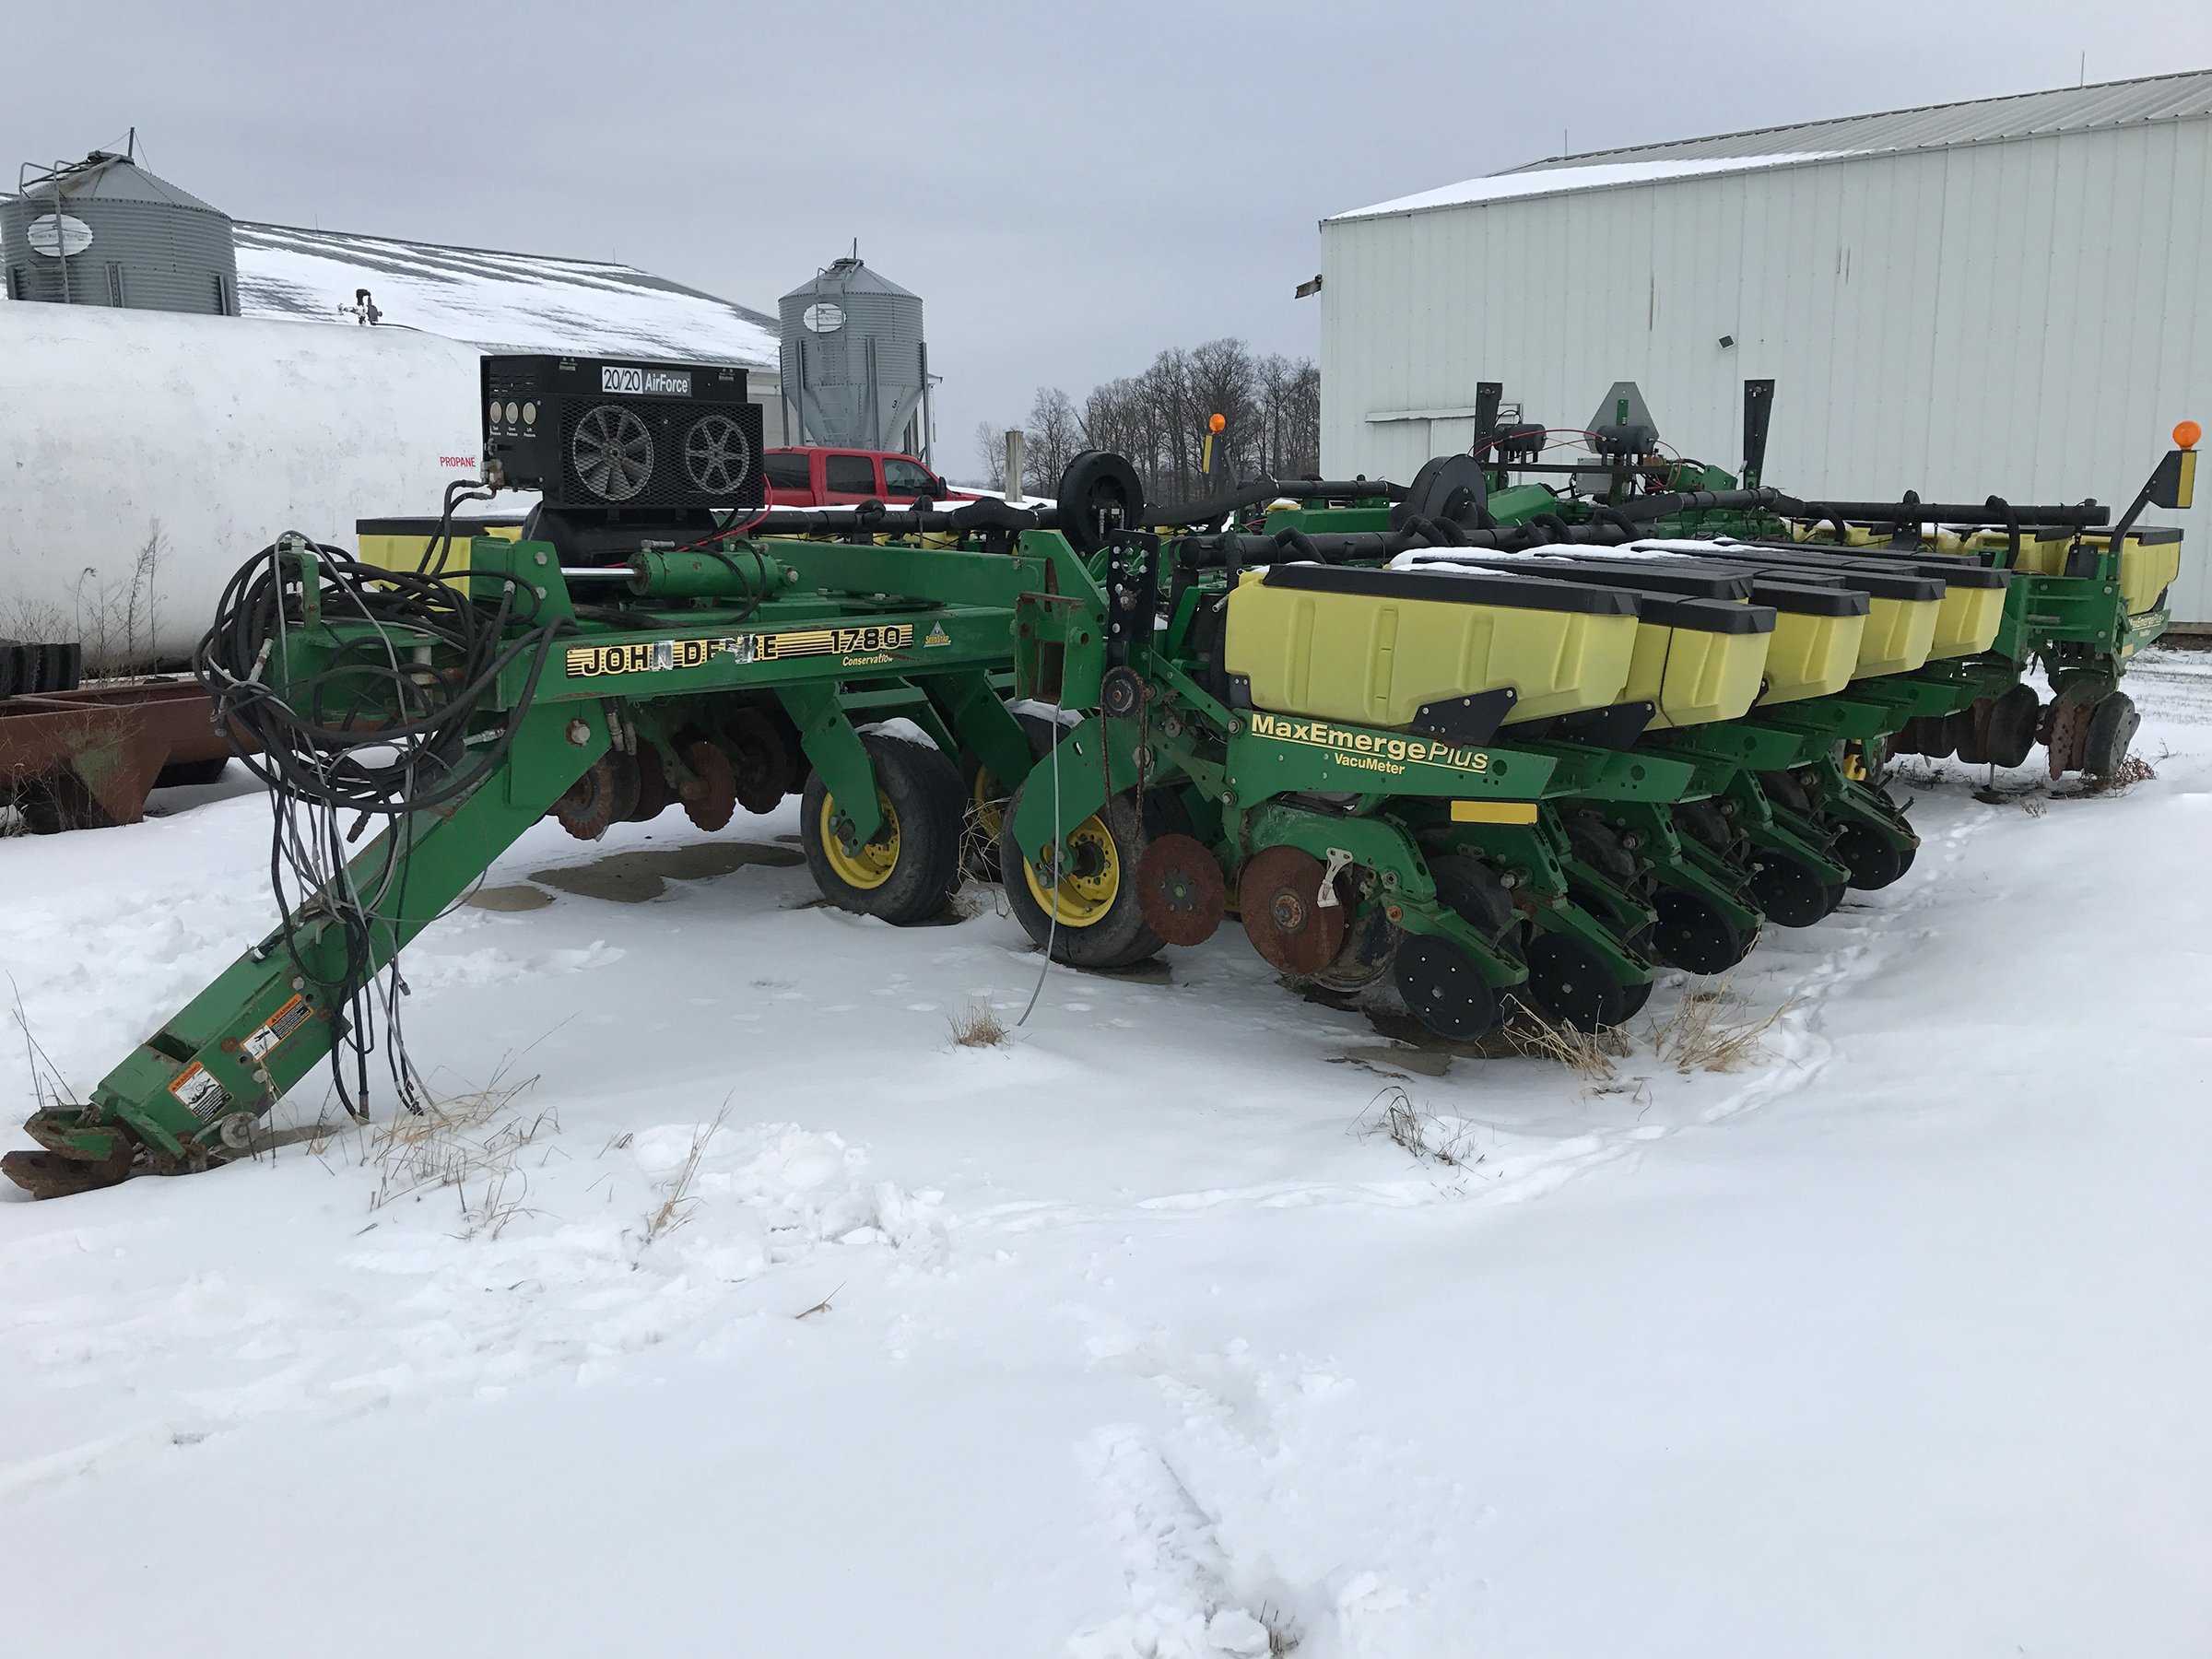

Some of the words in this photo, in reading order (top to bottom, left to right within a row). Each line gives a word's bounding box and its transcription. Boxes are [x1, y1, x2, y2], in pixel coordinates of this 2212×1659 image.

[604, 369, 641, 392] 20/20
[645, 372, 688, 394] AirForce
[891, 399, 898, 409] 3
[439, 456, 476, 467] PROPANE
[830, 624, 900, 654] 1780
[1252, 713, 1488, 770] MaxEmergePlus
[1335, 752, 1406, 775] VacuMeter
